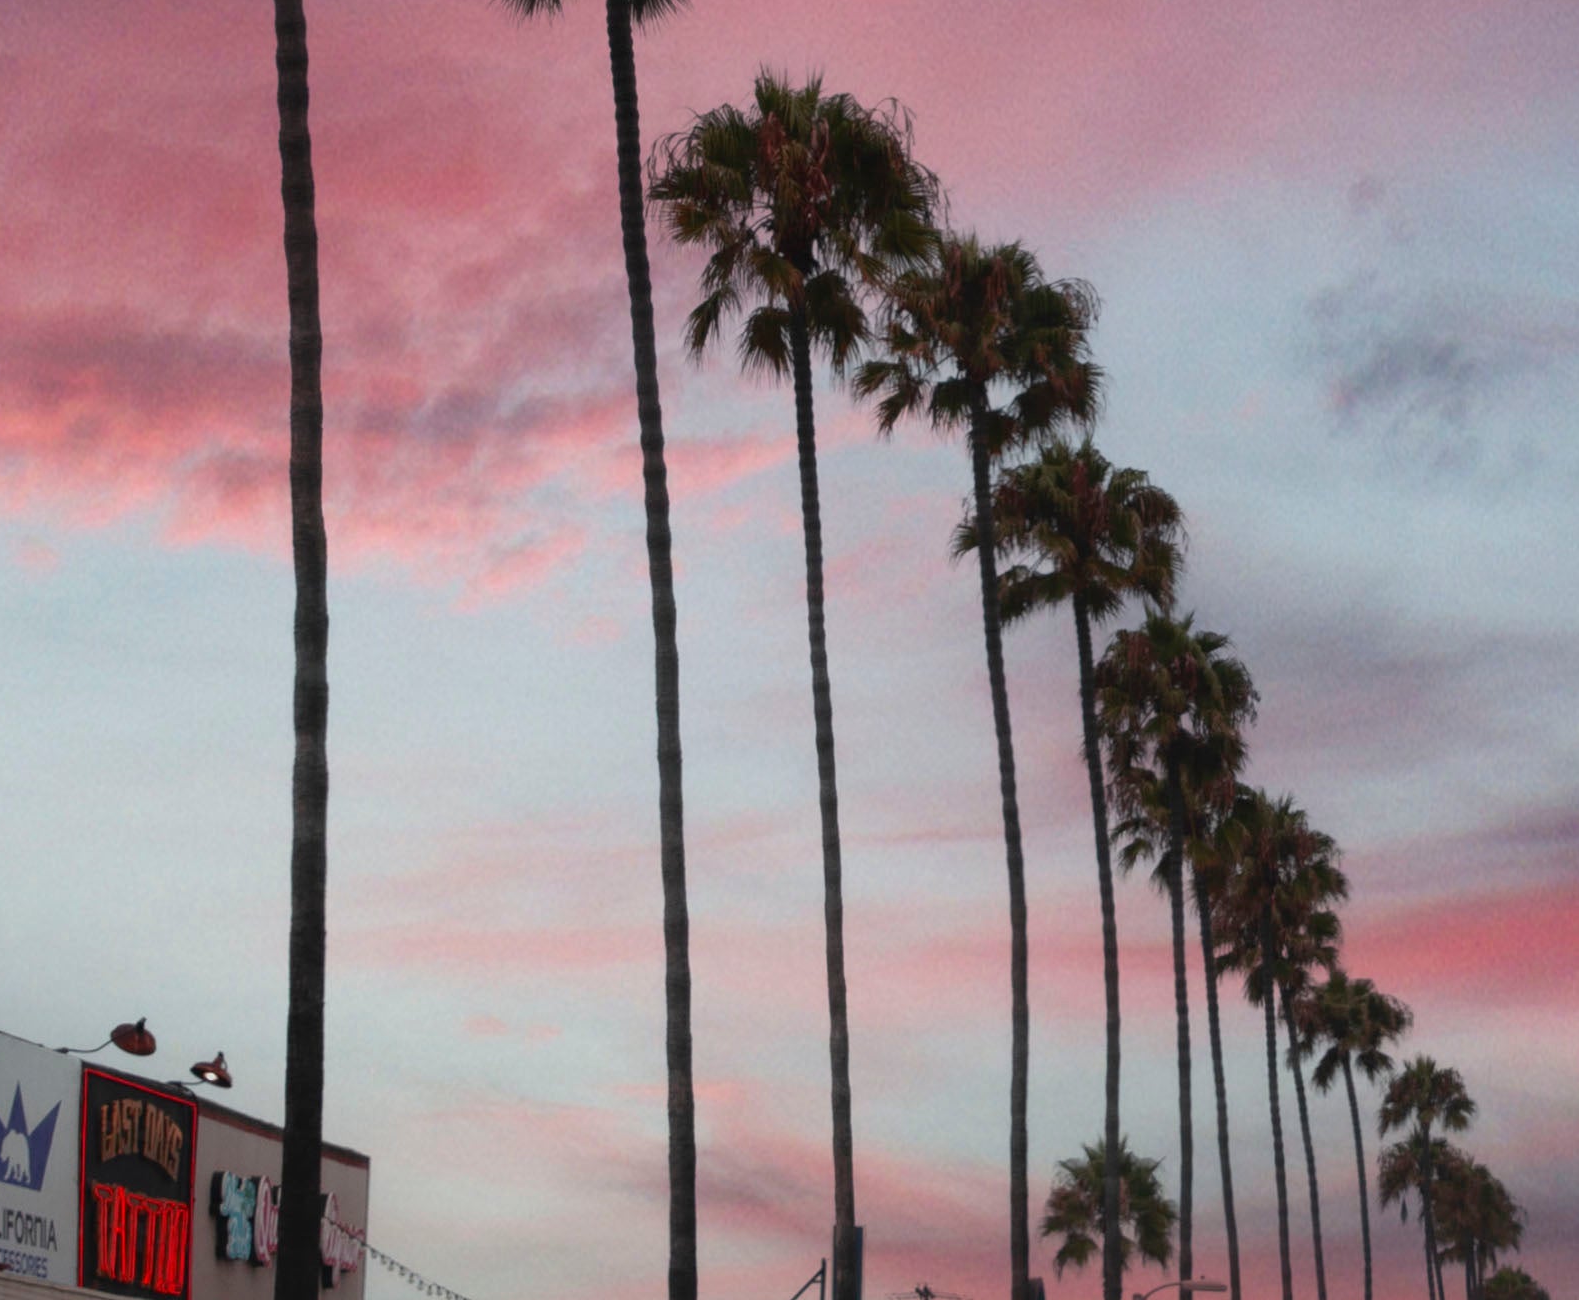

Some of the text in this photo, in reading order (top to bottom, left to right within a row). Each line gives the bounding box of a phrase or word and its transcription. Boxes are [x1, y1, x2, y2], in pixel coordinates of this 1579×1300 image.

[100, 1097, 184, 1182] LAST DAYS
[92, 1184, 189, 1296] TATTOO
